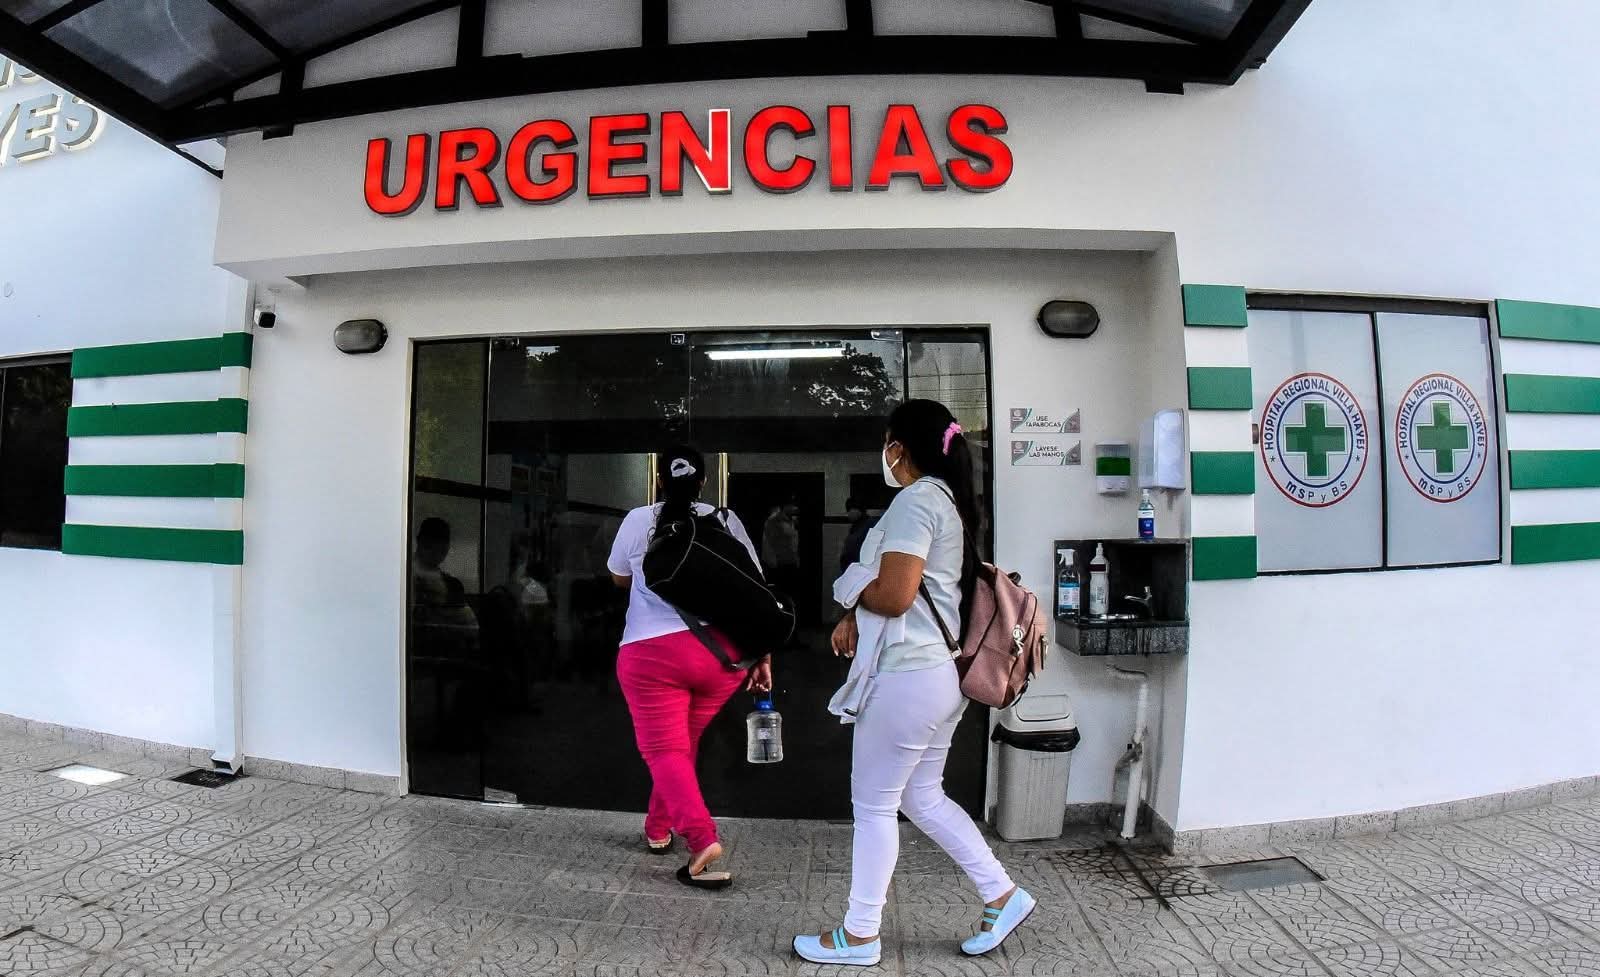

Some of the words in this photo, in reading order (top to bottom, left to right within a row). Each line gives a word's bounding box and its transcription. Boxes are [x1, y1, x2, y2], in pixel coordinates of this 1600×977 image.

[363, 103, 1014, 217] URGENCIAS
[1264, 398, 1285, 450] HOSPITAL
[1283, 378, 1330, 399] REGIONAL
[1333, 384, 1355, 414] VILLA
[1351, 412, 1365, 450] HAYES
[1399, 398, 1416, 449] HOSPITAL
[1413, 379, 1453, 400] REGIONAL
[1456, 387, 1476, 413] VILLA
[1473, 412, 1485, 447] HAYES
